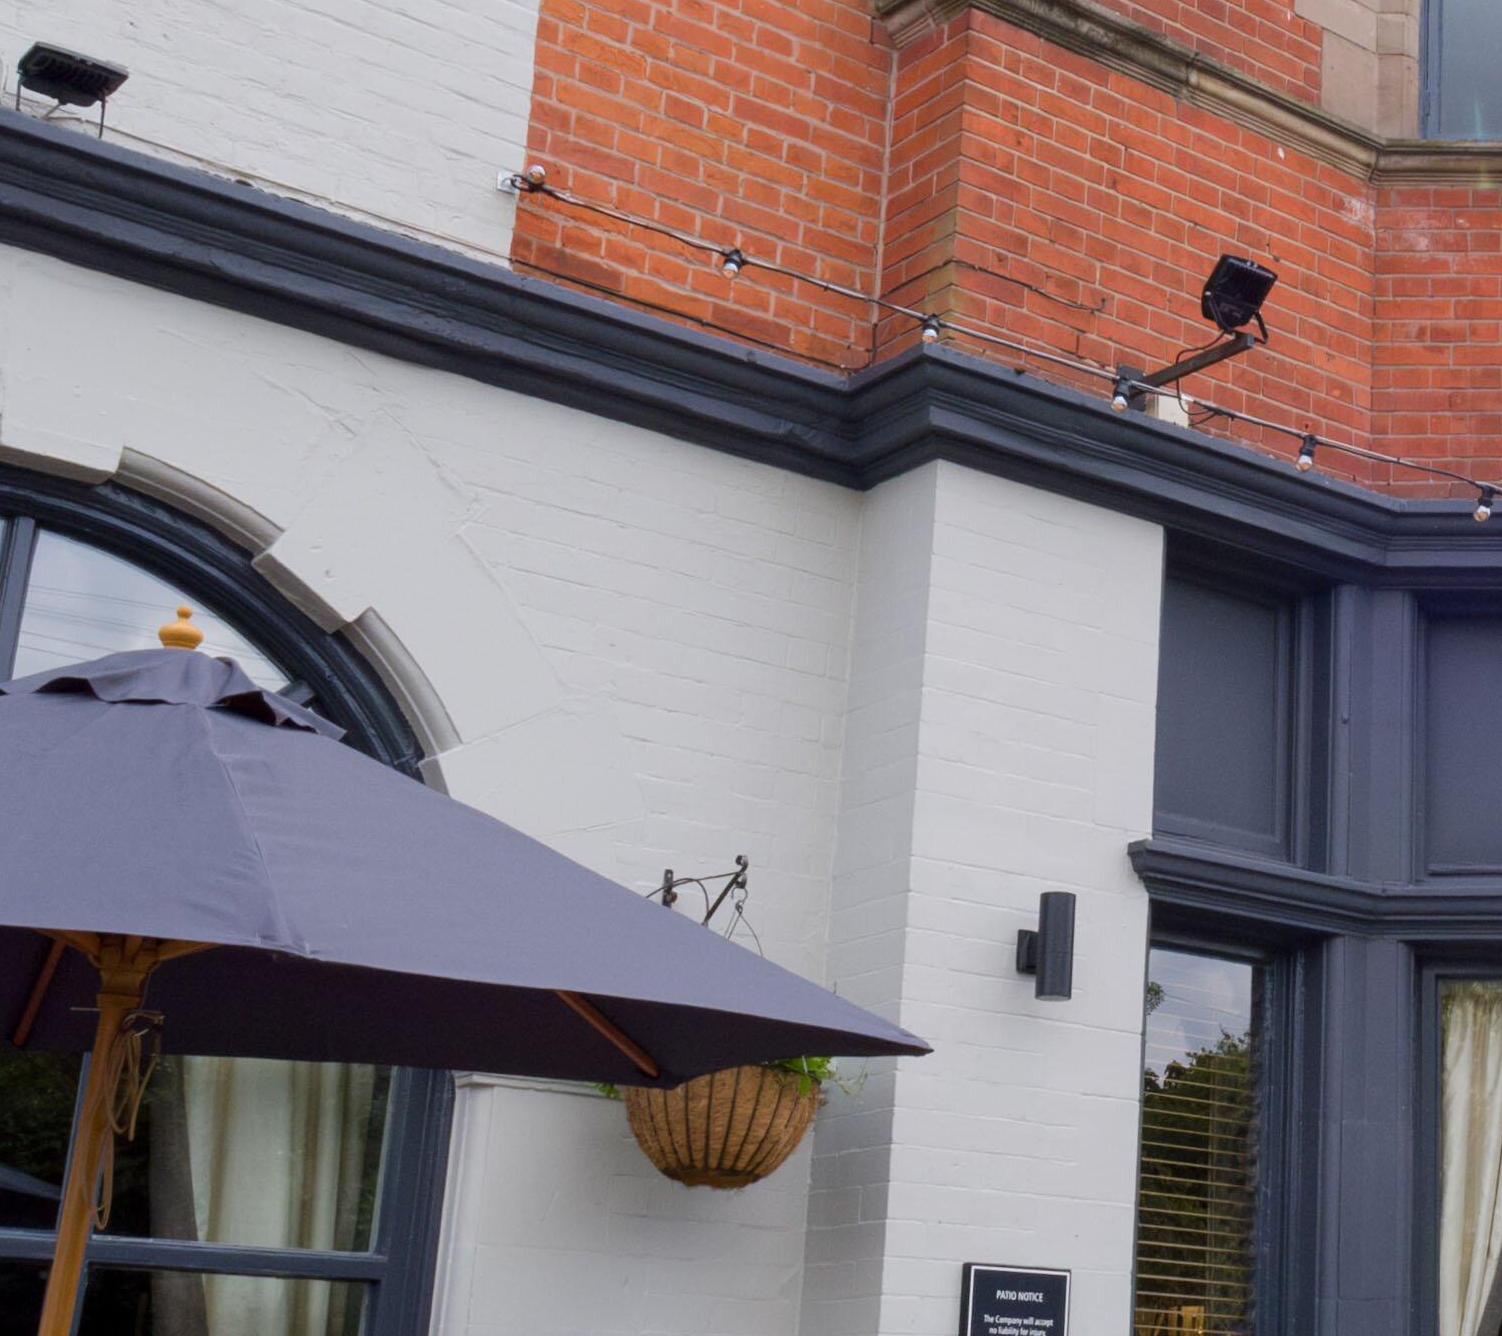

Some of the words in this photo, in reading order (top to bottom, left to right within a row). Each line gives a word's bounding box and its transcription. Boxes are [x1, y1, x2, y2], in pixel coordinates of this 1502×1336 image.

[996, 1290, 1017, 1301] PATIO
[1018, 1291, 1043, 1303] NOTICE
[984, 1314, 994, 1324] The
[995, 1315, 1022, 1326] Company
[1023, 1317, 1034, 1325] will
[1034, 1319, 1053, 1327] accept
[998, 1326, 1019, 1336] liability
[1020, 1327, 1029, 1336] for
